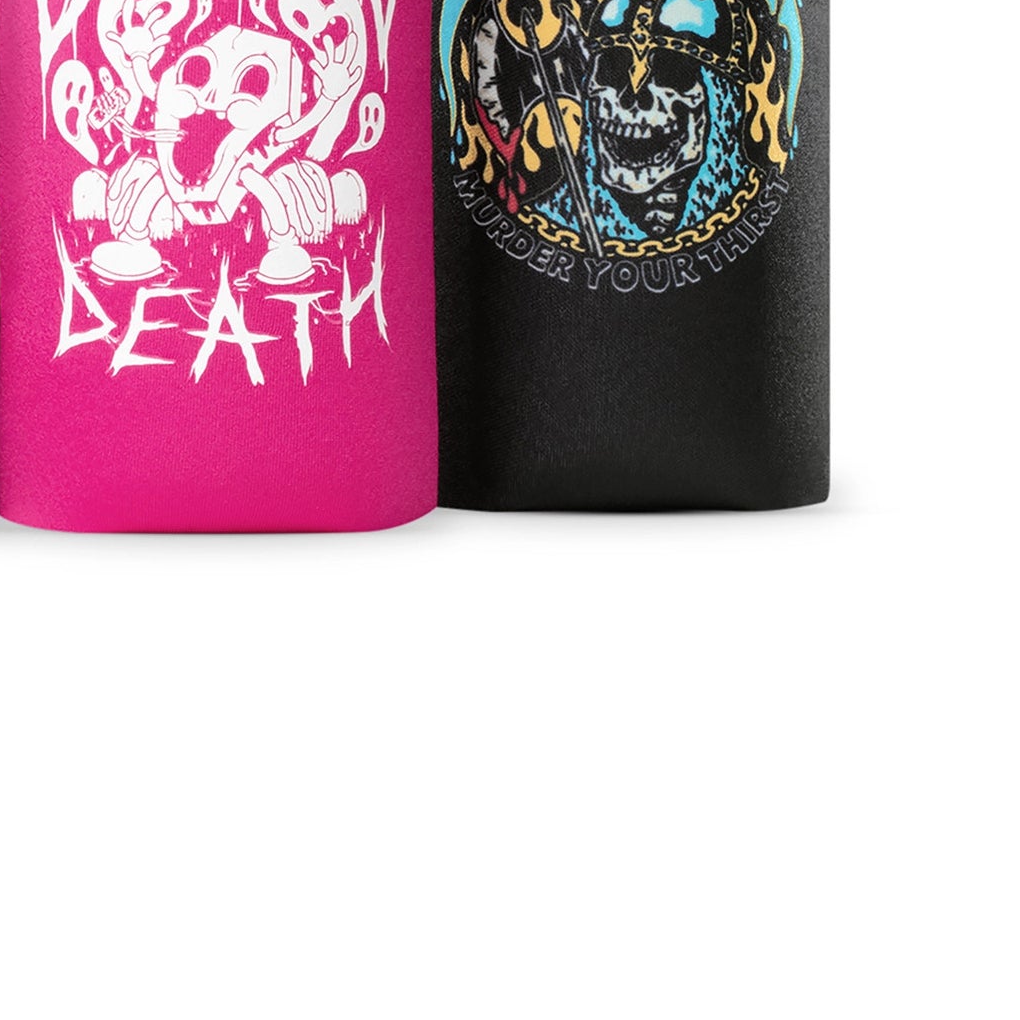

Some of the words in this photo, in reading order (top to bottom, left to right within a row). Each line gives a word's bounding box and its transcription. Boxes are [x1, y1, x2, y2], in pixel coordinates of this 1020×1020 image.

[52, 204, 394, 387] DEATH
[453, 170, 575, 281] MURDER
[583, 251, 701, 293] YOUR
[698, 164, 791, 273] THIRST
